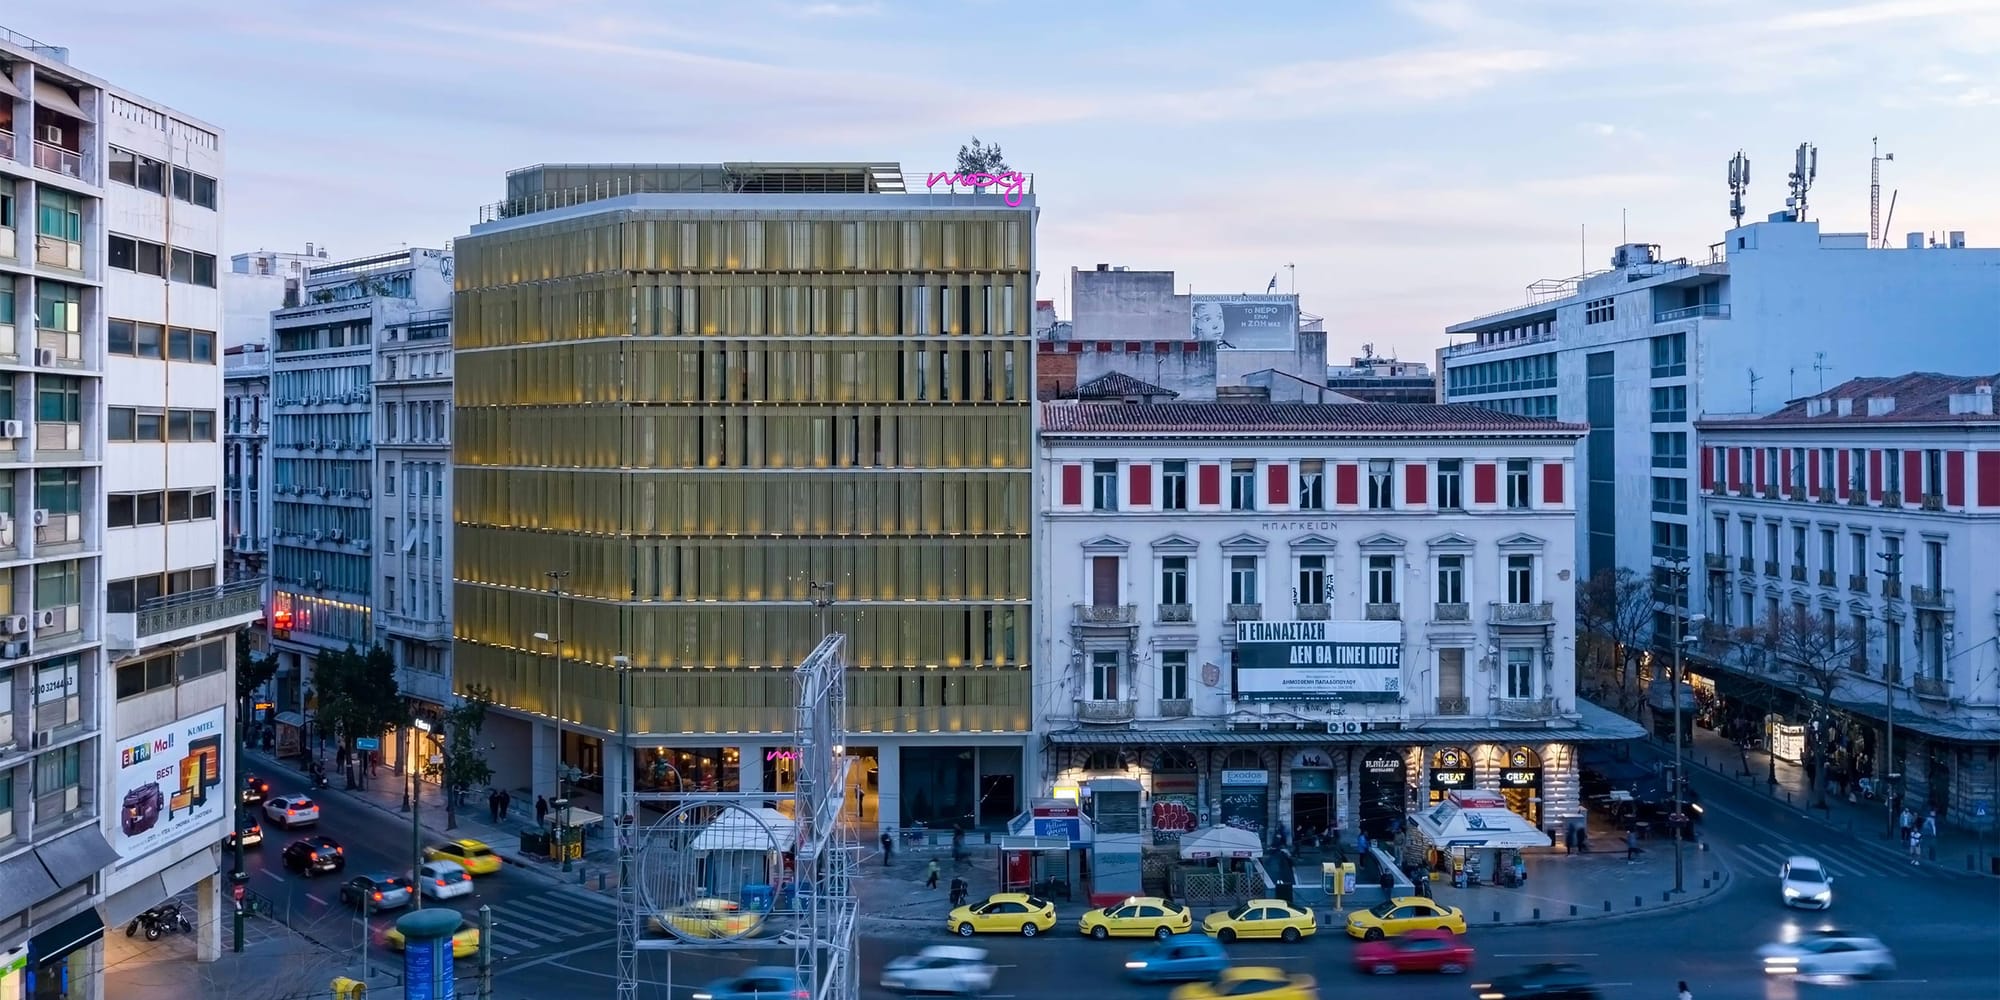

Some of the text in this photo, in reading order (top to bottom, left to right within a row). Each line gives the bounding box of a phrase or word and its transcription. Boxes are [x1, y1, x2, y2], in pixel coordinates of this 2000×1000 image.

[926, 171, 1026, 207] moxy
[1254, 306, 1278, 314] ΝΕΡΟ
[1262, 522, 1338, 530] ΜΠΑΓΚΕΙΟΝ
[1239, 622, 1326, 641] Η ΕΠΑΝΑΣΤΑΣΗ
[1289, 646, 1399, 665] ΔΕΝ ΘΑ ΓΙΝΕΙ ΠΟΤΕ
[122, 743, 151, 768] EXTRA
[156, 765, 174, 781] BEST
[1437, 773, 1465, 781] GREAT
[1506, 772, 1535, 781] GREAT
